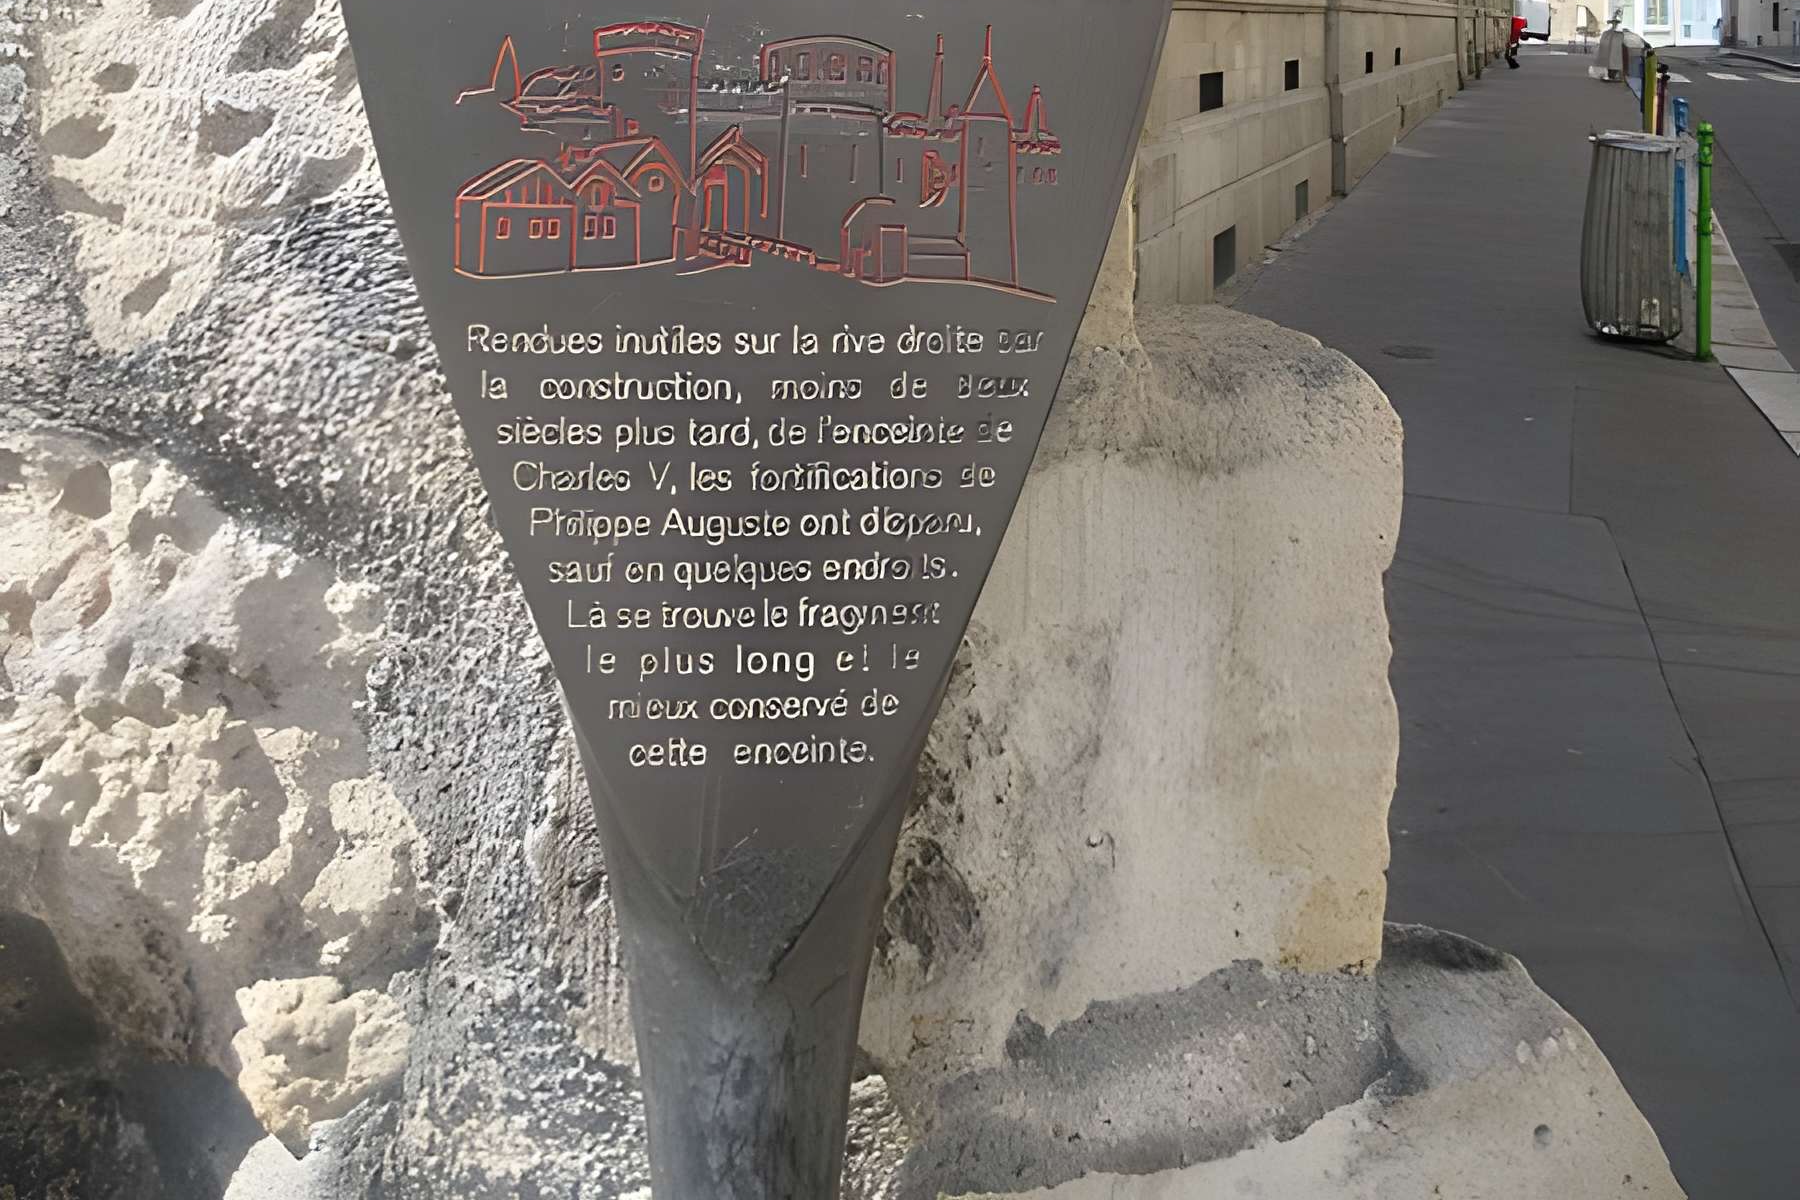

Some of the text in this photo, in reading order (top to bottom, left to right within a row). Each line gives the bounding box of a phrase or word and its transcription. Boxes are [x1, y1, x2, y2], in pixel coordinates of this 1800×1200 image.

[468, 325, 604, 354] Rendues
[616, 325, 720, 354] inutiles
[734, 332, 780, 354] sur
[793, 326, 818, 354] la
[832, 326, 884, 354] rive
[898, 325, 984, 353] droite
[481, 372, 506, 398] la
[540, 372, 742, 403] construction,
[772, 374, 862, 398] moins
[891, 372, 926, 398] de
[496, 416, 602, 445] siècles
[616, 418, 674, 451] plus
[688, 418, 758, 449] tard,
[768, 416, 806, 445] de
[513, 461, 630, 492] Charles
[649, 461, 675, 494] V,
[690, 462, 731, 491] les
[960, 464, 996, 488] de
[662, 508, 789, 544] Auguste
[801, 511, 850, 537] ont
[549, 552, 958, 590] sauf en quelques endrots.
[568, 600, 605, 628] Là
[616, 607, 650, 629] se
[662, 603, 755, 630] trouve
[763, 599, 788, 628] le
[586, 643, 920, 681] le plus long et le
[608, 689, 899, 719] mieux conservé de
[630, 735, 875, 766] cette enceinte.
